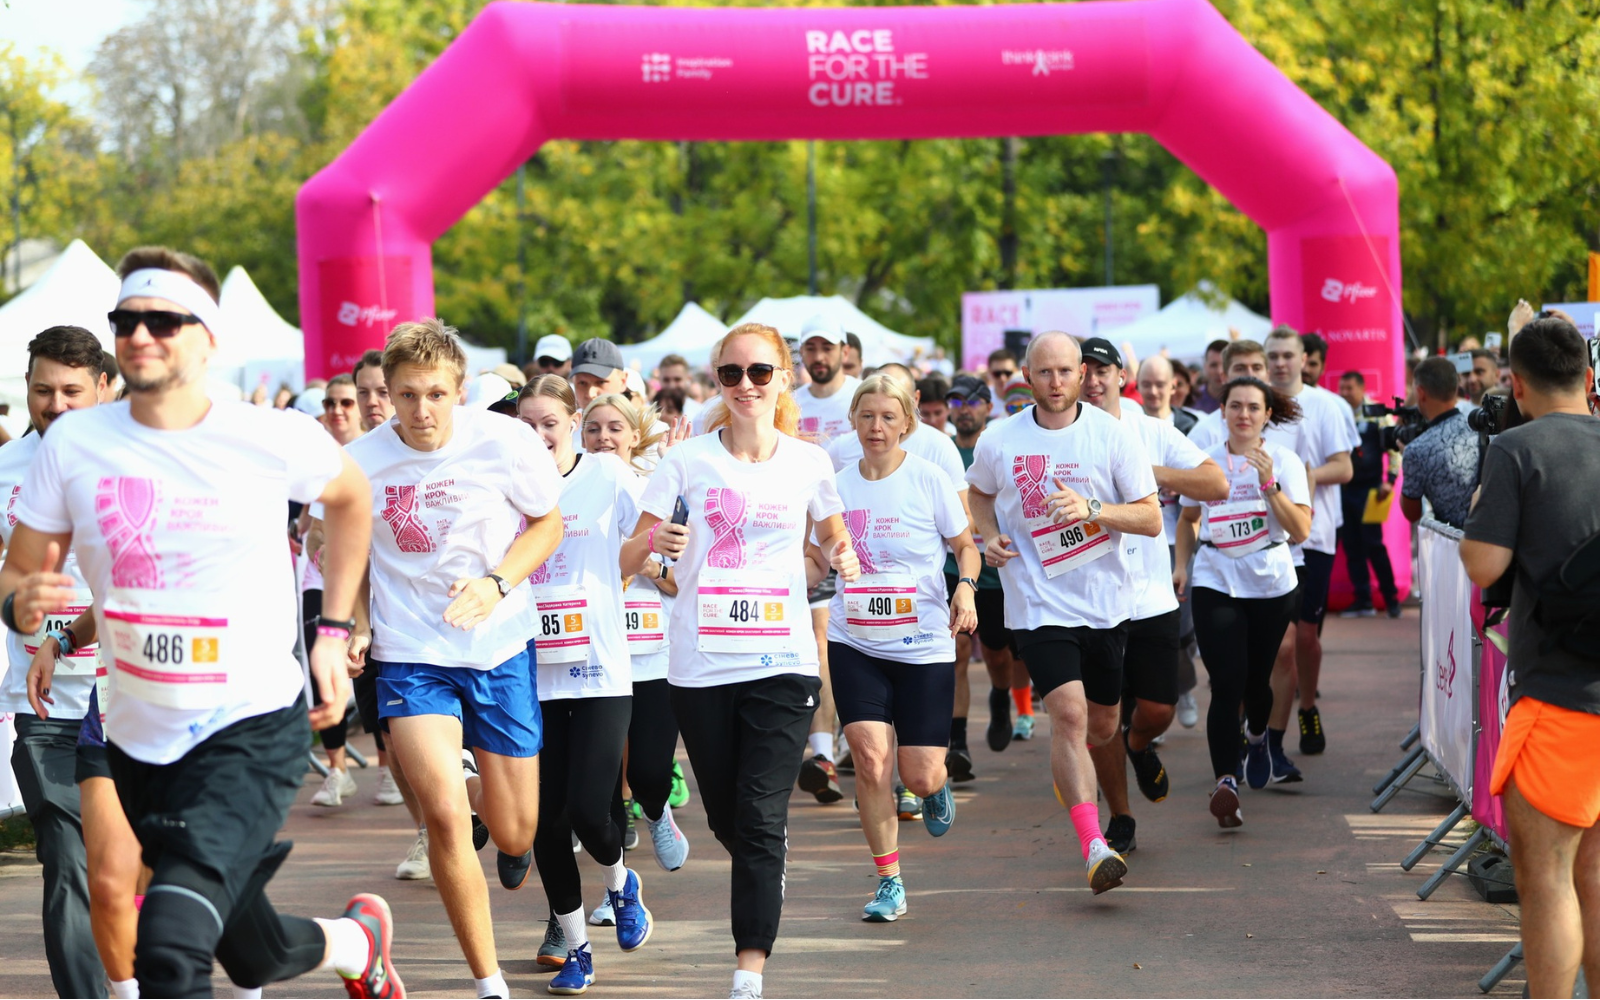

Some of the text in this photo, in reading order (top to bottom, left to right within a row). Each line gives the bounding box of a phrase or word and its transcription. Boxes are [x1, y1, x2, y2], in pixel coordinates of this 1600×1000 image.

[805, 28, 894, 54] RACE
[676, 57, 733, 69] Inspiration
[807, 52, 930, 81] FOR THE
[676, 68, 713, 80] Family
[808, 81, 904, 107] CURE.
[1328, 329, 1387, 342] NOVARTIS
[426, 479, 455, 491] КОЖЕН
[424, 490, 447, 500] КРОК
[425, 493, 470, 509] ВАЖЛИВИЙ
[758, 503, 788, 511] КОЖЕН
[562, 514, 578, 522] ЖЕН
[755, 512, 778, 520] КРОК
[752, 520, 797, 530] ВАЖЛИВИЙ
[1229, 521, 1251, 538] 173
[563, 527, 589, 538] ЛИВИЙ
[872, 530, 910, 539] ВАЖЛИВИЙ
[1059, 526, 1084, 548] 496
[770, 603, 777, 613] 5
[868, 597, 892, 616] 490
[900, 599, 907, 608] 5
[729, 599, 760, 622] 484
[539, 613, 560, 635] 85
[570, 615, 577, 625] 5
[647, 614, 653, 622] 5
[143, 633, 183, 664] 486
